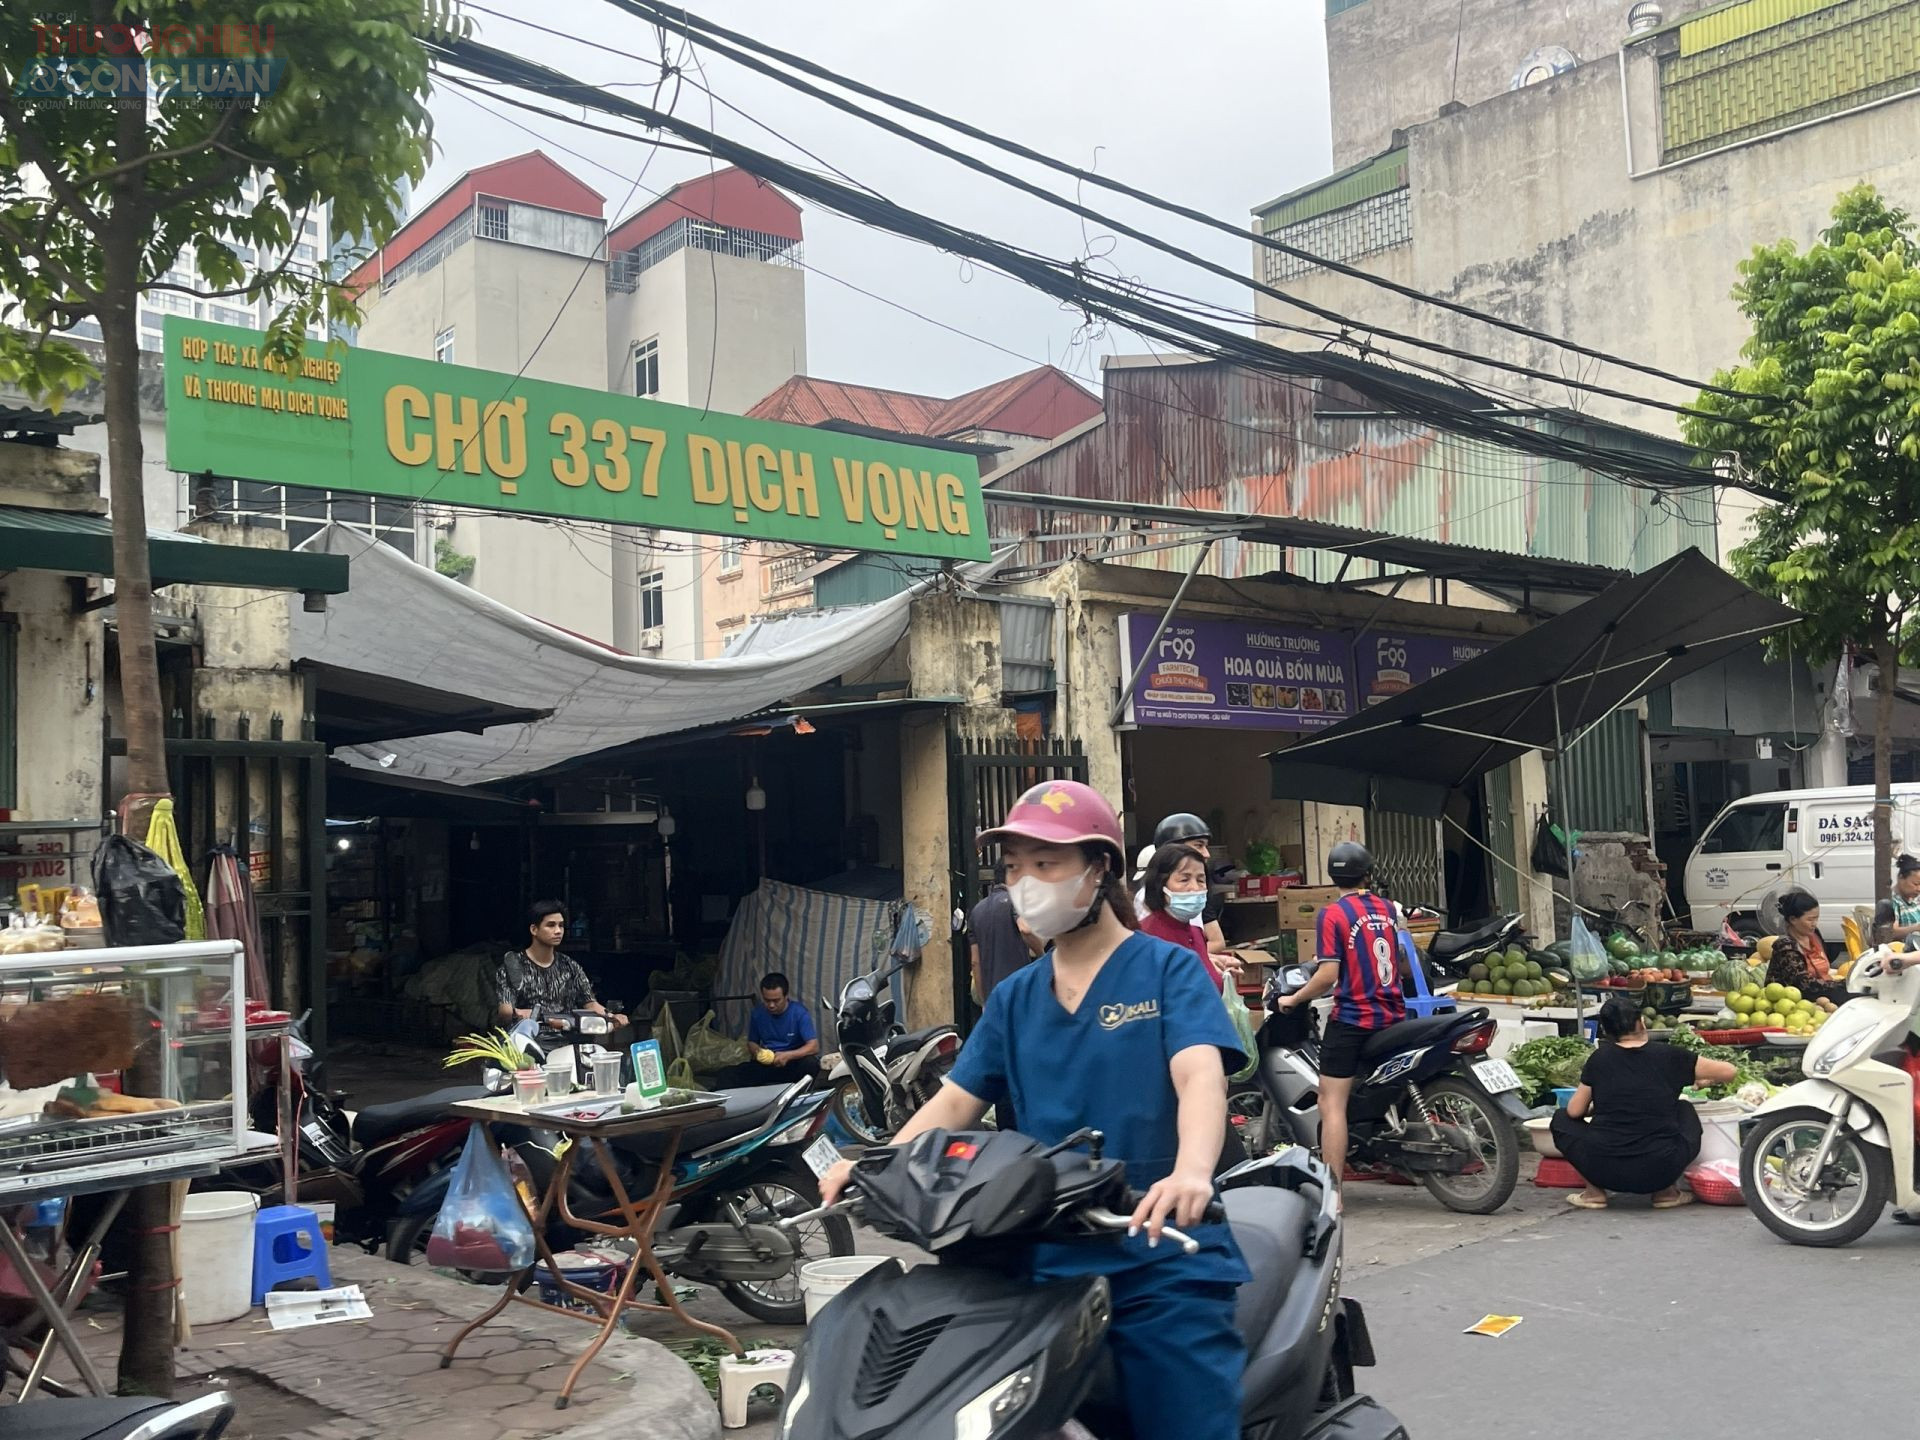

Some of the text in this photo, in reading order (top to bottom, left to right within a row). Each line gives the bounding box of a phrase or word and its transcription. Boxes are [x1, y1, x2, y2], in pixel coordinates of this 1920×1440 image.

[182, 336, 208, 363] HỢP
[213, 339, 237, 366] TÁC
[300, 357, 341, 385] NGHIỆP
[184, 373, 348, 421] VÀ THƯƠNG MẠI DỊCH VỌNG
[384, 384, 971, 540] CHỢ 337 DỊCH VỌNG
[1224, 656, 1344, 684] HOA QUẢ BỐN MÙA
[1818, 814, 1875, 830] ĐÁ SẠC
[1372, 936, 1393, 987] 8
